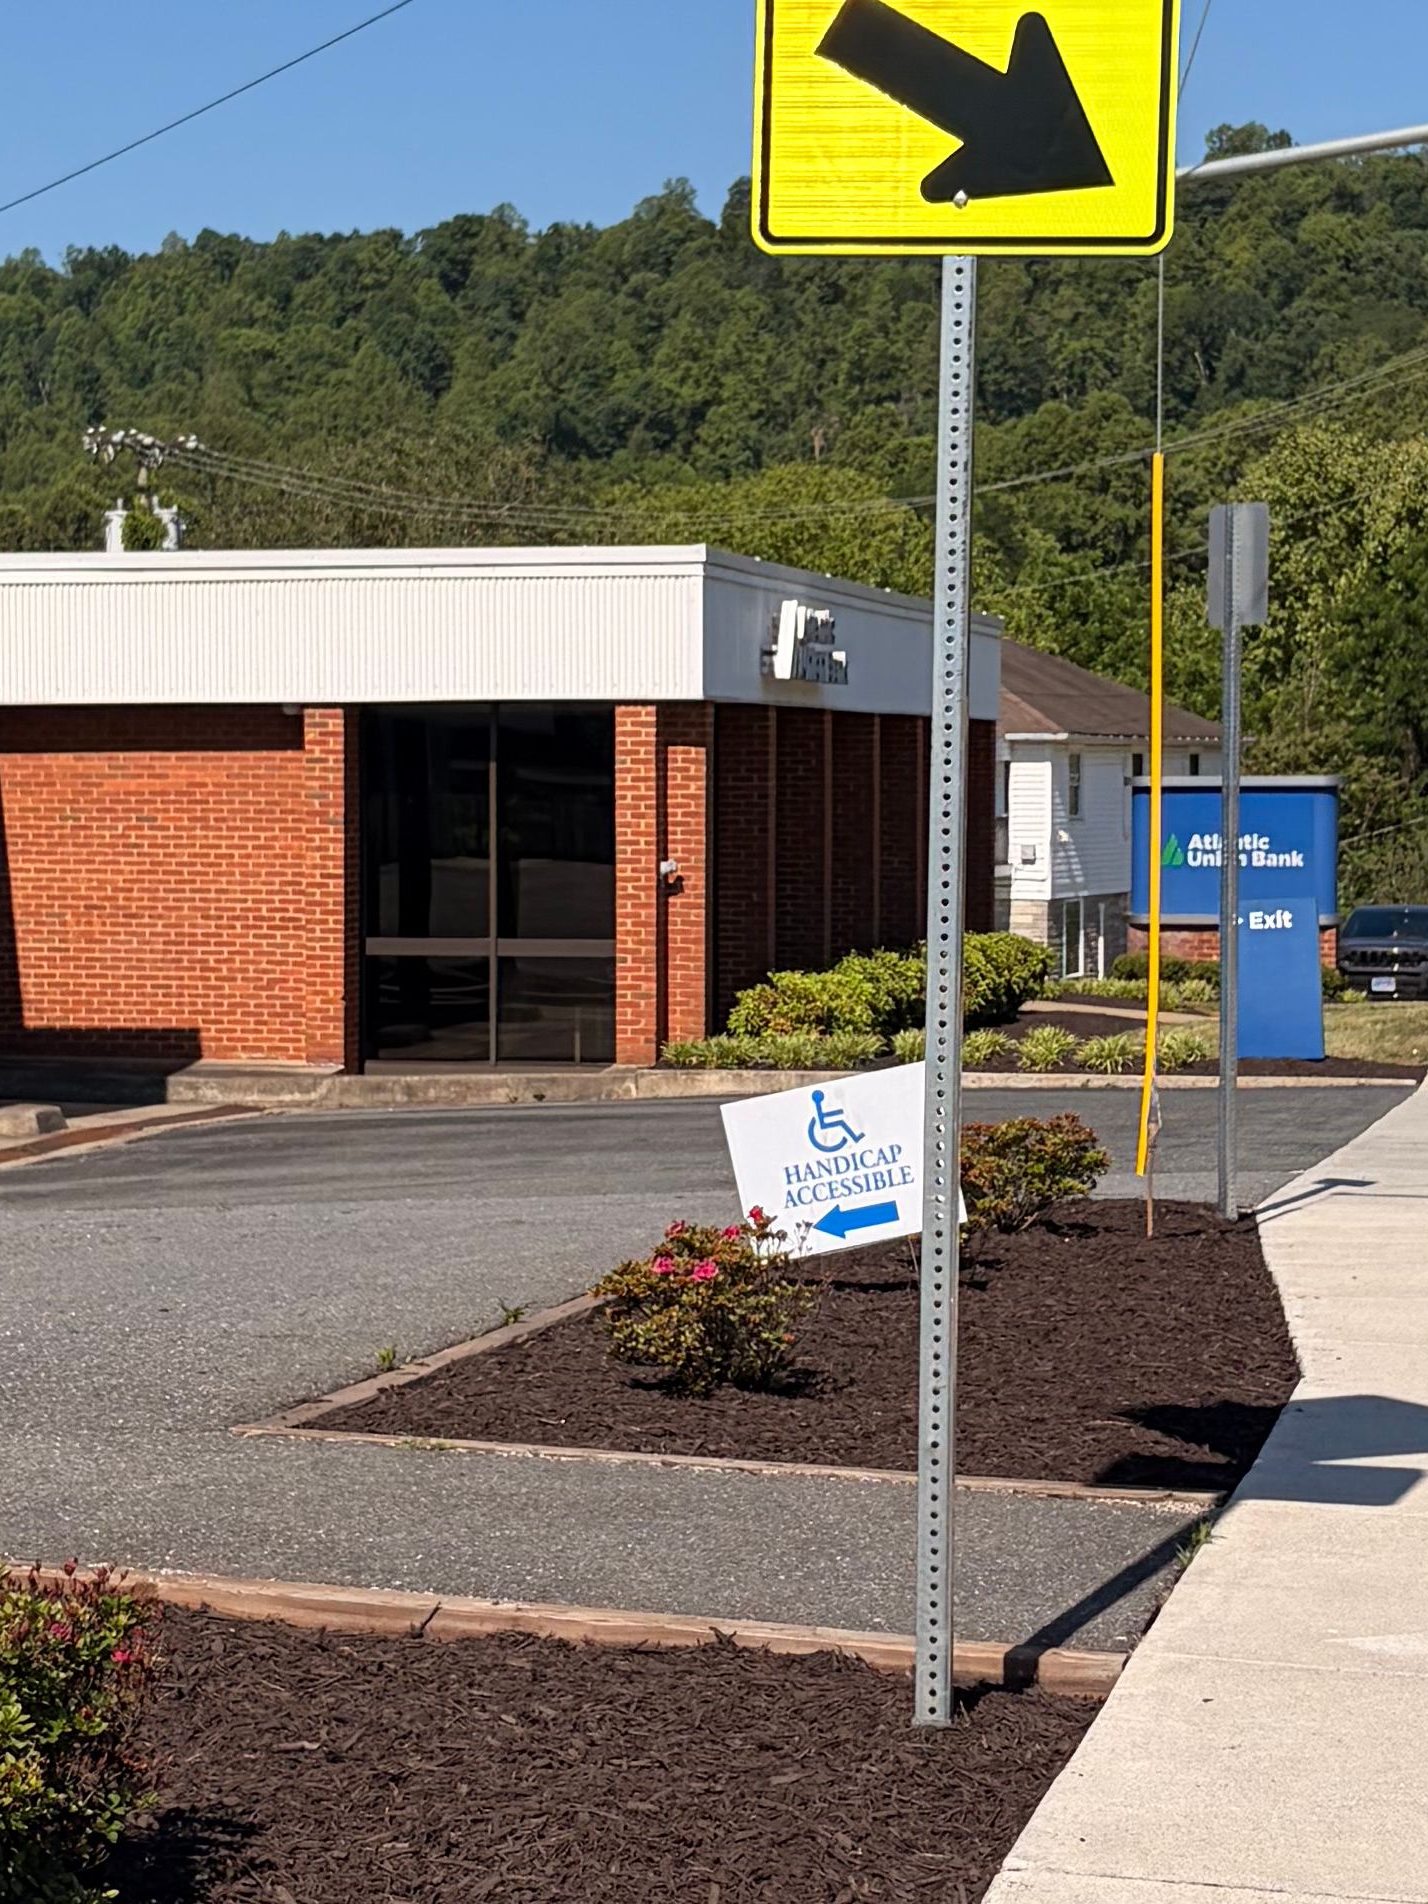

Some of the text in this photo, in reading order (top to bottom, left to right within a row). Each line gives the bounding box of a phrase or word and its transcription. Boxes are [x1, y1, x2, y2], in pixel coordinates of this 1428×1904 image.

[1188, 833, 1270, 851] Atltic
[1187, 850, 1304, 868] Unin Bank
[1249, 909, 1293, 930] Exit
[783, 1143, 903, 1186] HANDICAP
[783, 1165, 915, 1210] ACCESSIBLE
